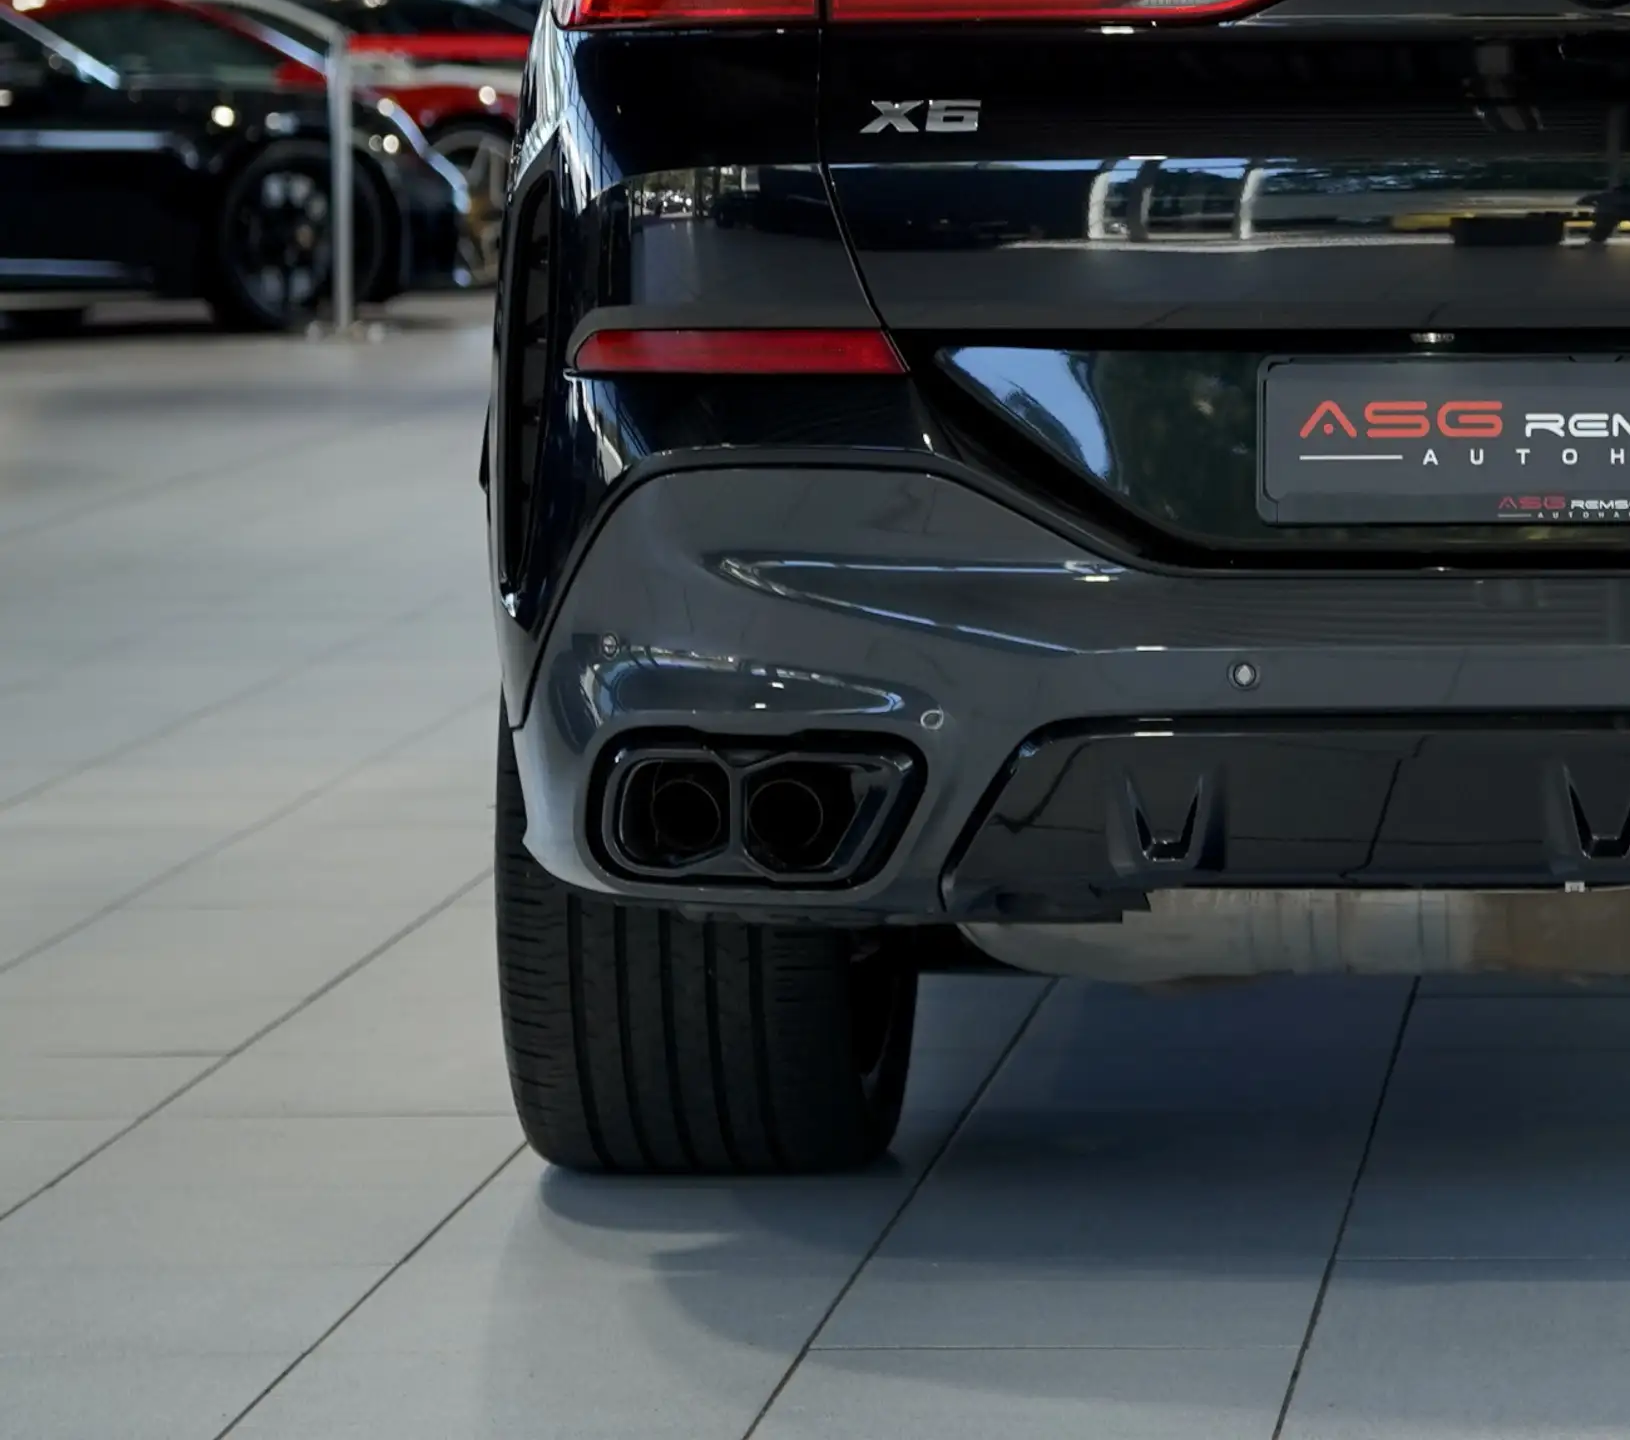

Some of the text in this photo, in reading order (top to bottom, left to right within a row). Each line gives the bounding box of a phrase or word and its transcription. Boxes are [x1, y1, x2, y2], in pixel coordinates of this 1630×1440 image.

[859, 99, 981, 133] X6
[1300, 400, 1503, 438] ASG
[1499, 496, 1566, 510] ASG
